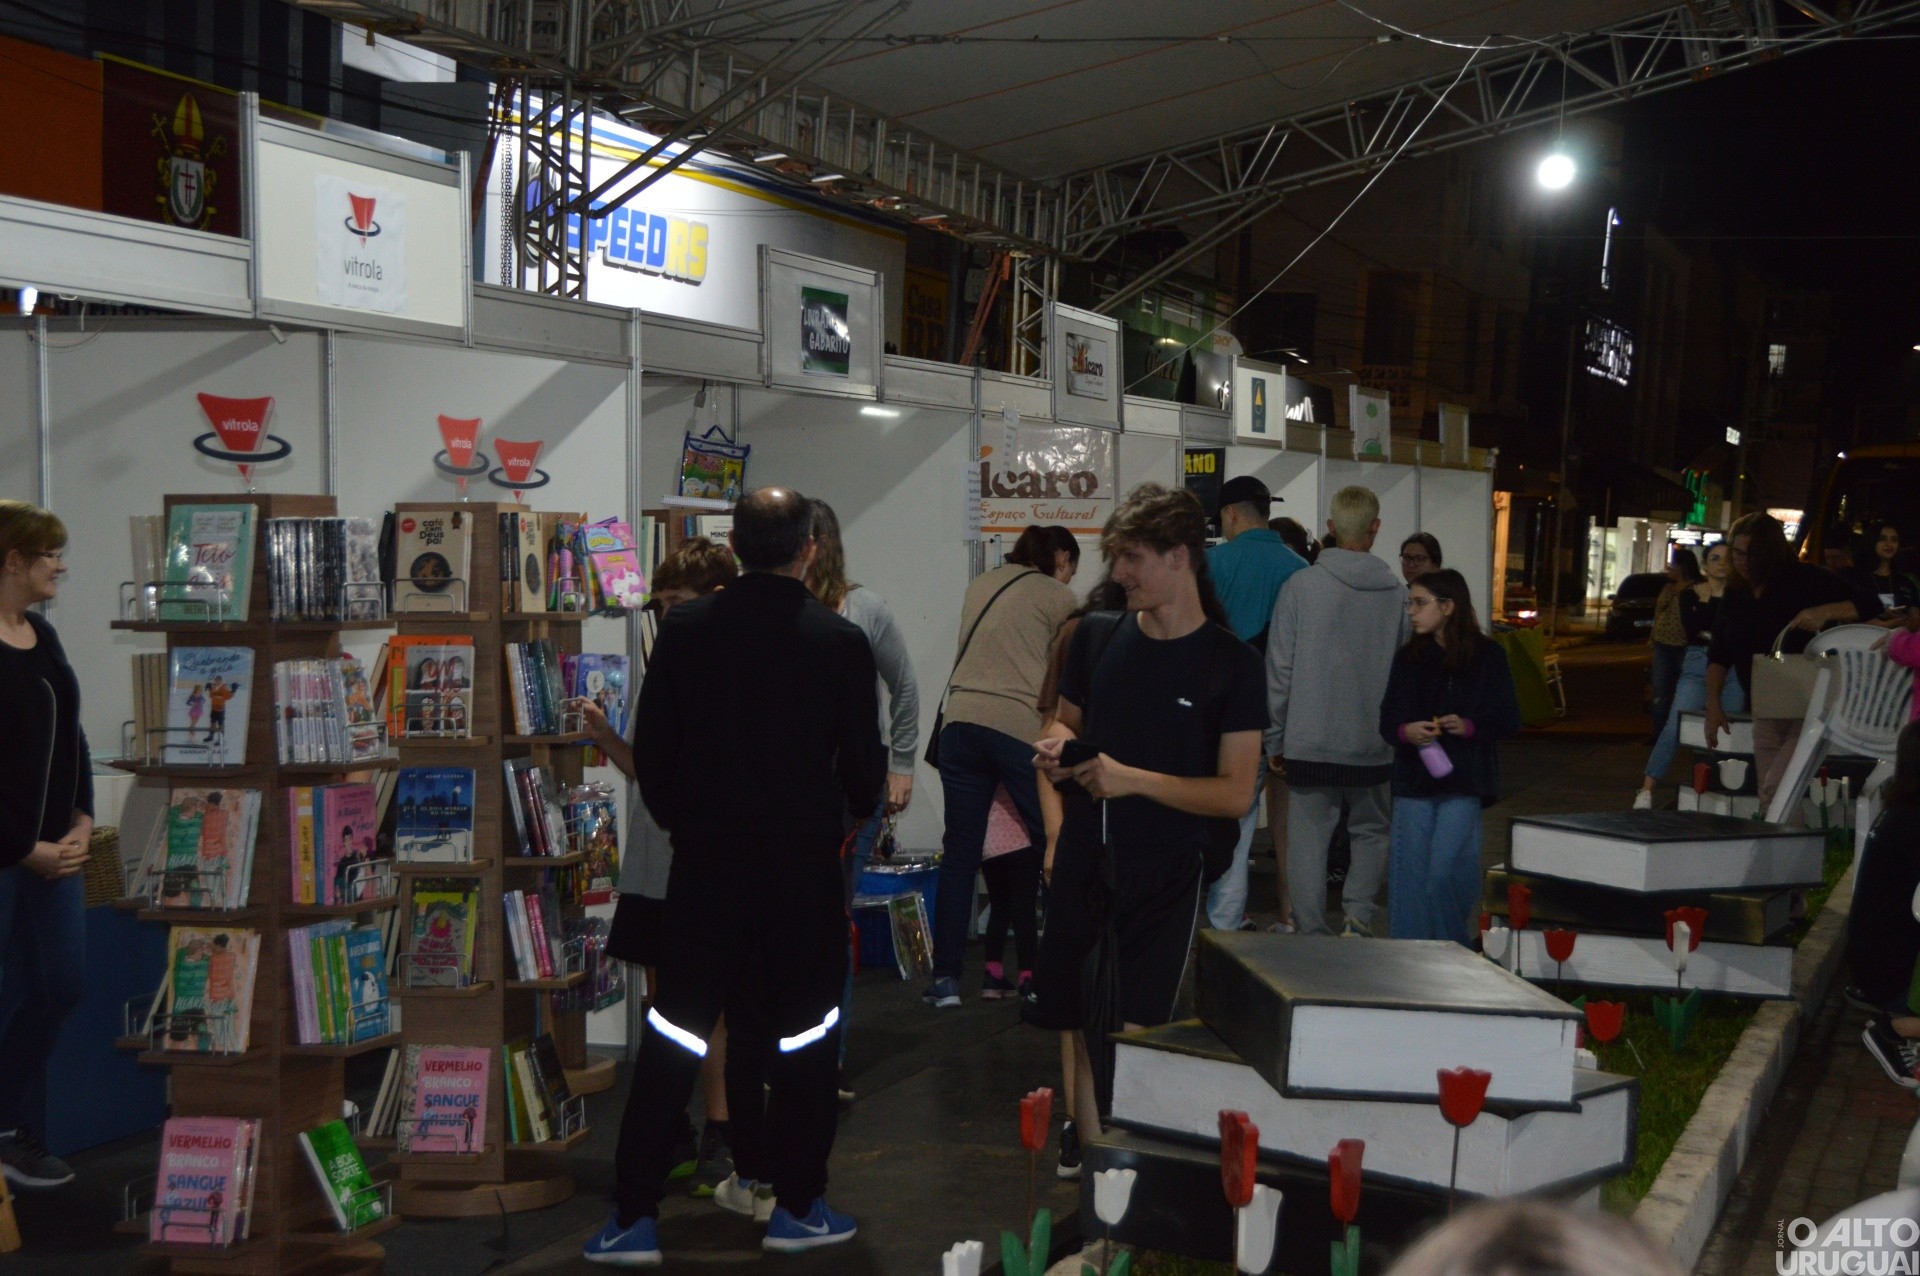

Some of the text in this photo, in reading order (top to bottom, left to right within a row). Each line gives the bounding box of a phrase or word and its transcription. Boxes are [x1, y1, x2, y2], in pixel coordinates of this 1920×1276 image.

[344, 256, 383, 280] vitrola
[809, 332, 849, 354] GABARITO
[222, 419, 259, 431] vitrola
[451, 438, 473, 449] vitrola
[508, 457, 531, 467] vitrola
[1031, 503, 1097, 521] Cultural
[422, 519, 444, 527] café
[420, 531, 444, 539] Deus
[193, 543, 235, 566] Teto
[425, 1061, 483, 1073] VERMELHO
[424, 1076, 472, 1088] BRANCO
[424, 1094, 480, 1108] SANGUE
[169, 1134, 232, 1149] VERMELHO
[168, 1153, 219, 1168] BRANCO
[168, 1174, 227, 1191] SANGUE
